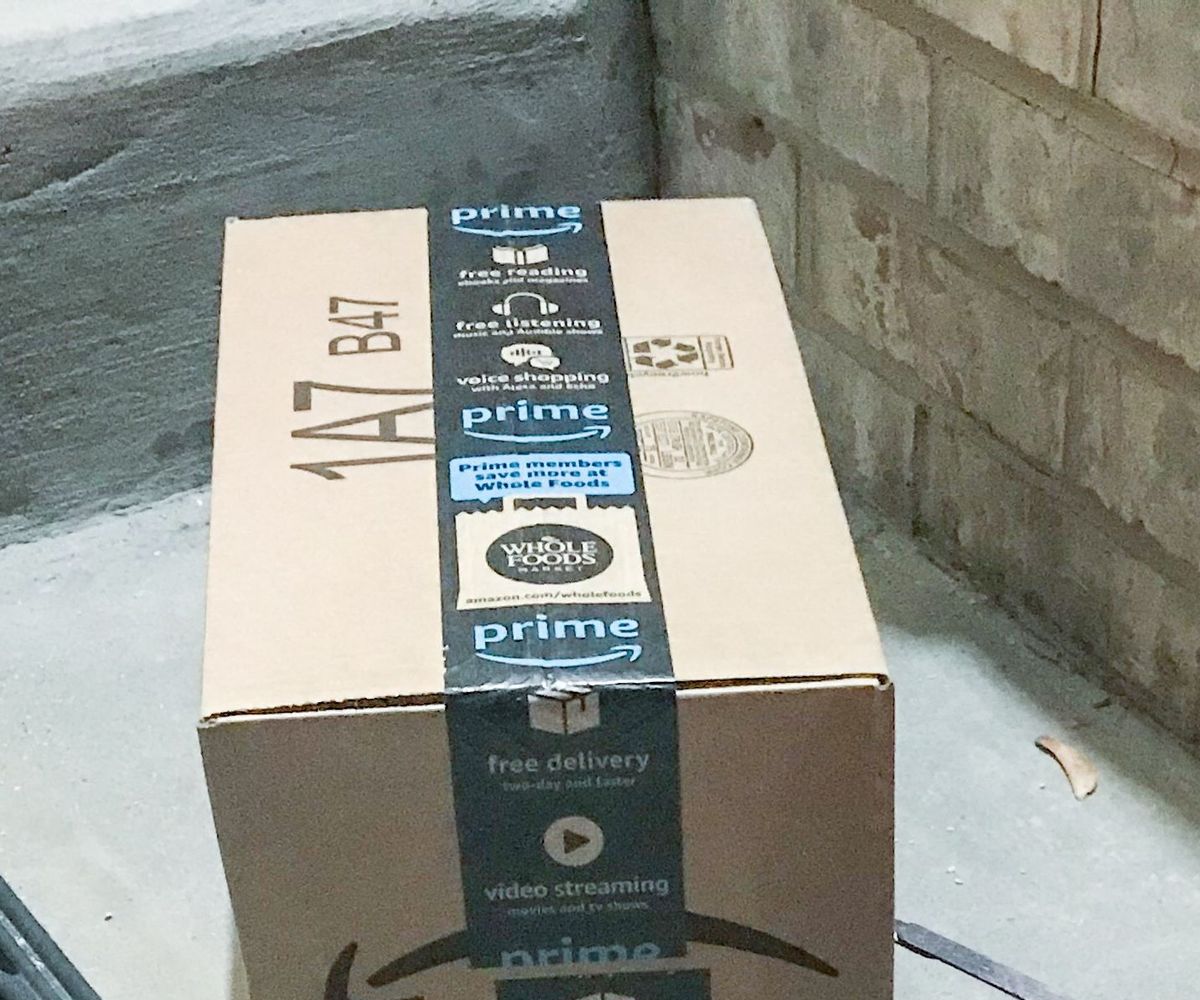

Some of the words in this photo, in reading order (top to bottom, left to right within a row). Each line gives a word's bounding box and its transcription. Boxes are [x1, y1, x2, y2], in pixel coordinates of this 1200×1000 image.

[451, 203, 581, 225] prime
[458, 269, 501, 279] free
[507, 267, 589, 278] reading
[328, 296, 401, 355] B47
[455, 321, 499, 331] free
[506, 318, 602, 330] listening
[457, 373, 510, 386] voice
[514, 371, 610, 384] shopping
[471, 384, 500, 393] with
[462, 400, 609, 429] prime
[290, 381, 434, 480] 1A7
[459, 461, 520, 473] Prime
[526, 459, 622, 468] members
[475, 470, 520, 481] save
[528, 469, 582, 478] more
[588, 468, 608, 477] at
[475, 480, 542, 492] Whole
[549, 478, 610, 488] Foods
[500, 540, 598, 555] WHOLE
[508, 552, 597, 567] FOODS
[518, 565, 584, 574] MARKET
[466, 589, 642, 604] amazon.com/wholefoods
[474, 614, 639, 650] prime
[487, 754, 538, 774] free
[547, 750, 650, 773] delivery
[484, 882, 548, 900] video
[555, 876, 669, 896] streaming
